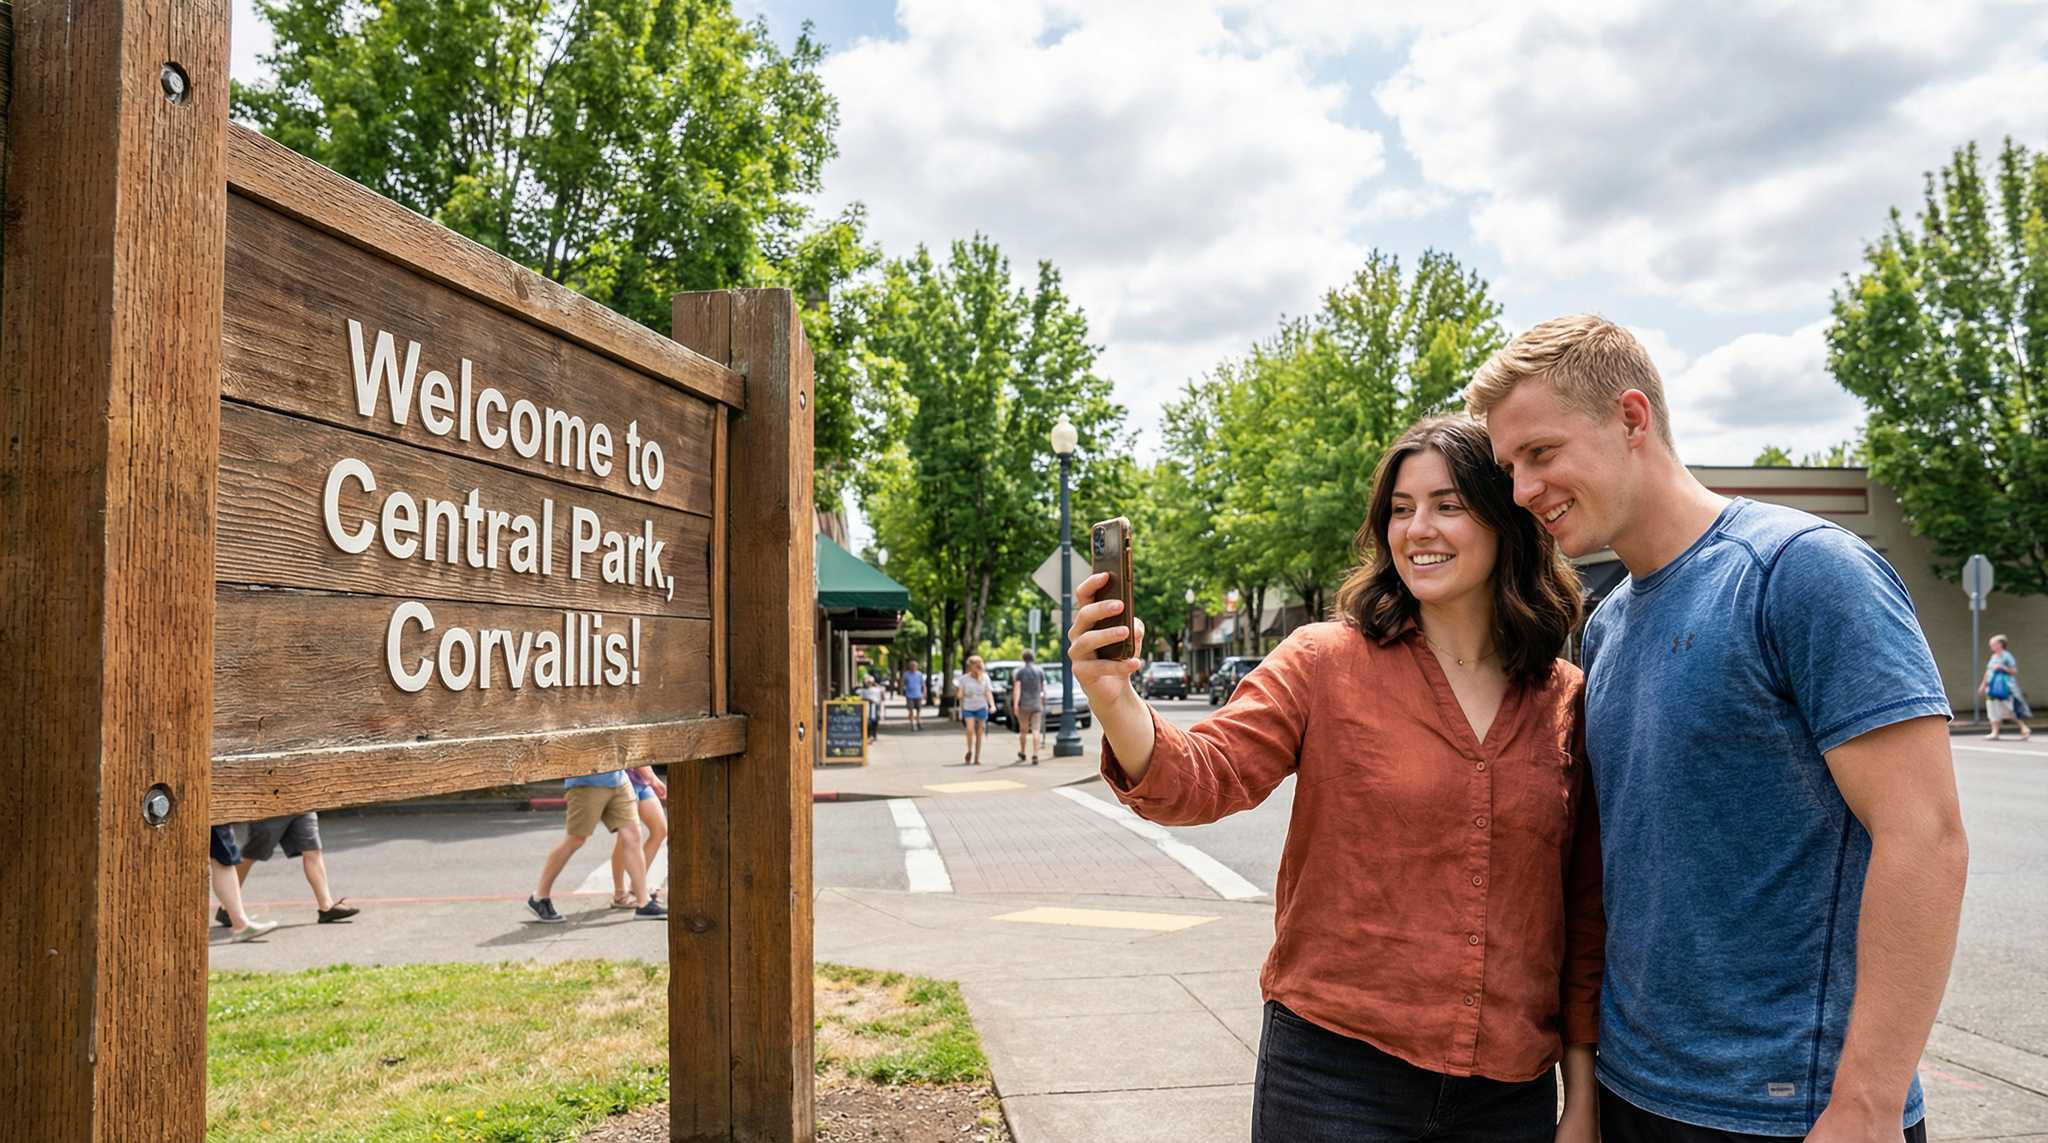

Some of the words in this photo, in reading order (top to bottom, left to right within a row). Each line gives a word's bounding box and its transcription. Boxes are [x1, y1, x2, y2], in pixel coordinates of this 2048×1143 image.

[346, 319, 613, 477] Welcome
[626, 420, 664, 490] to
[324, 457, 552, 575] Central
[571, 506, 674, 601] Park,
[387, 601, 641, 692] Corvallis!
